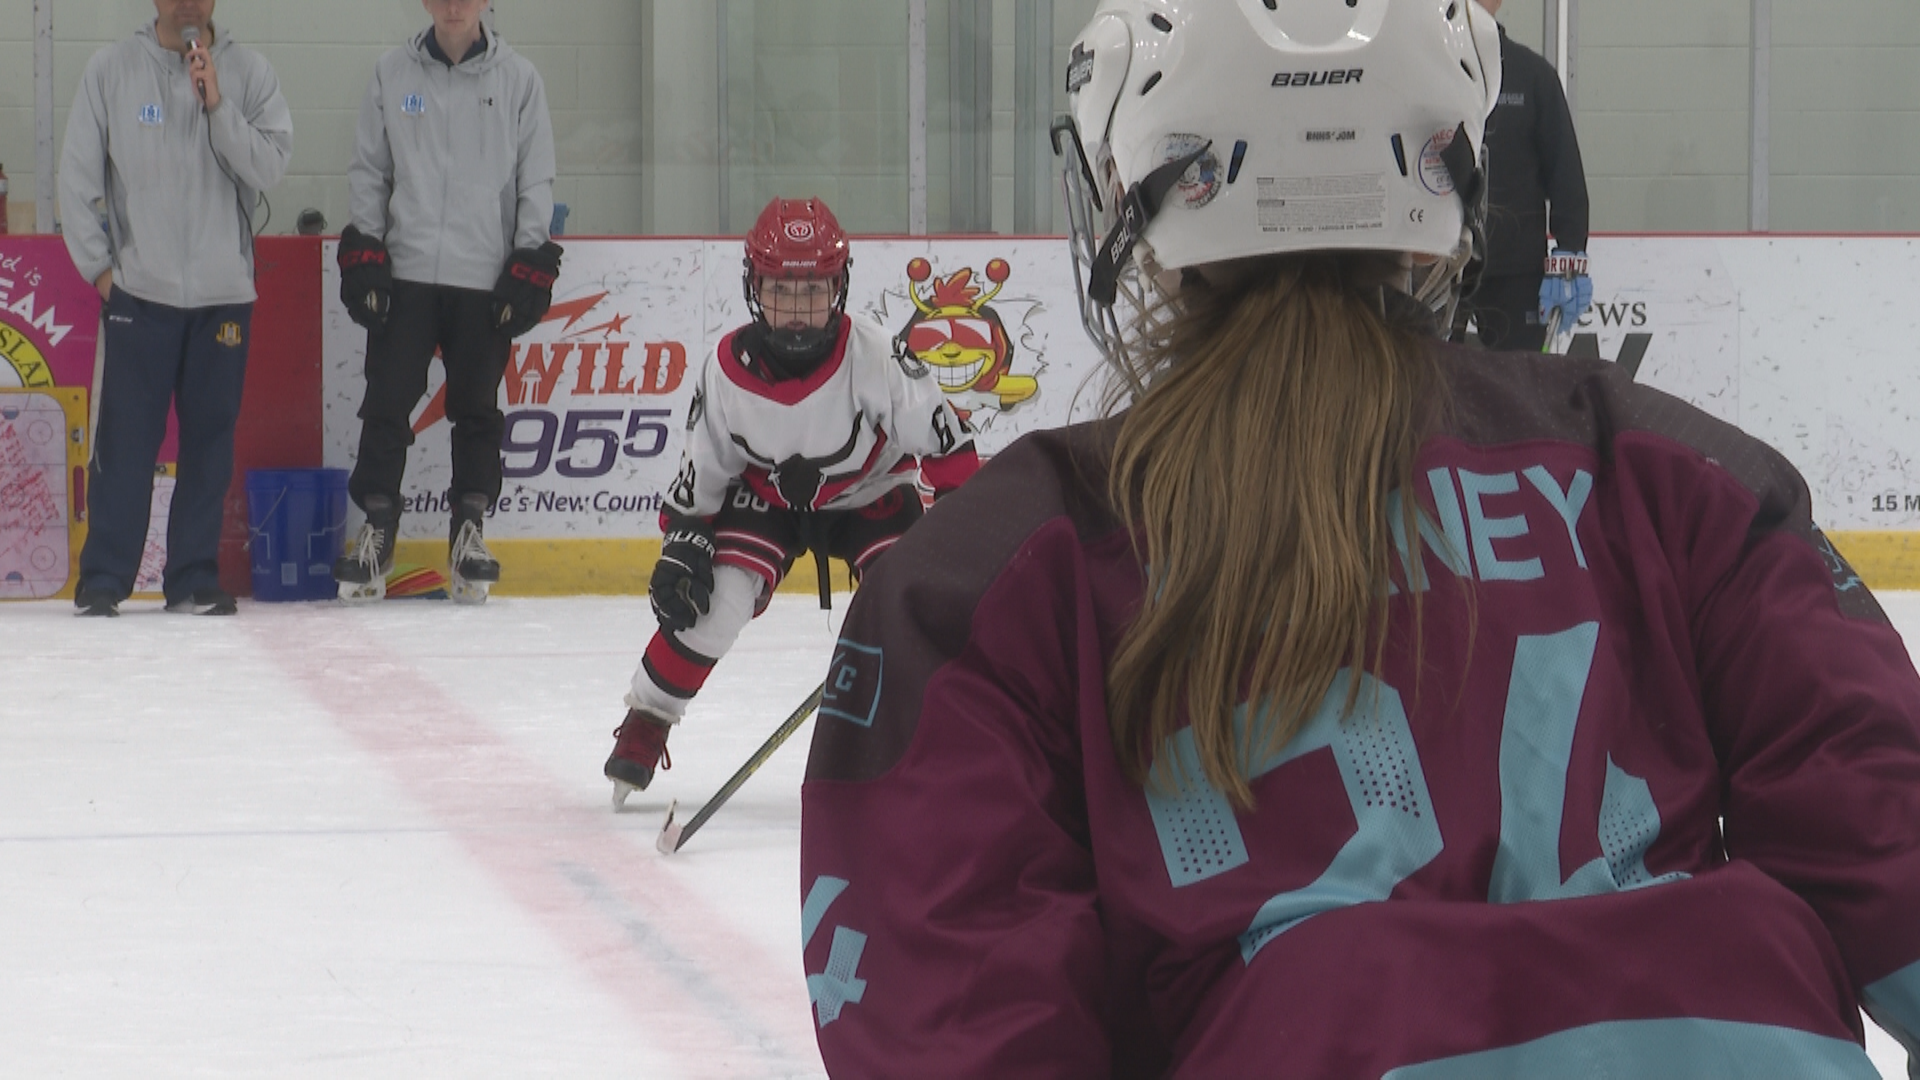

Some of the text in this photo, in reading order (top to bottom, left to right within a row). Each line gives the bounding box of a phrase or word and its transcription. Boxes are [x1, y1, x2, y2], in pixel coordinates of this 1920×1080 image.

[1271, 69, 1363, 87] BAUER
[1111, 207, 1135, 264] BAUR
[340, 249, 386, 269] CM
[511, 262, 555, 288] CC
[1577, 302, 1647, 326] ews
[504, 341, 688, 406] WILD
[535, 493, 588, 512] New
[593, 491, 662, 512] Count
[1872, 494, 1898, 512] 15
[1384, 464, 1593, 597] NEY
[663, 530, 716, 558] AUER
